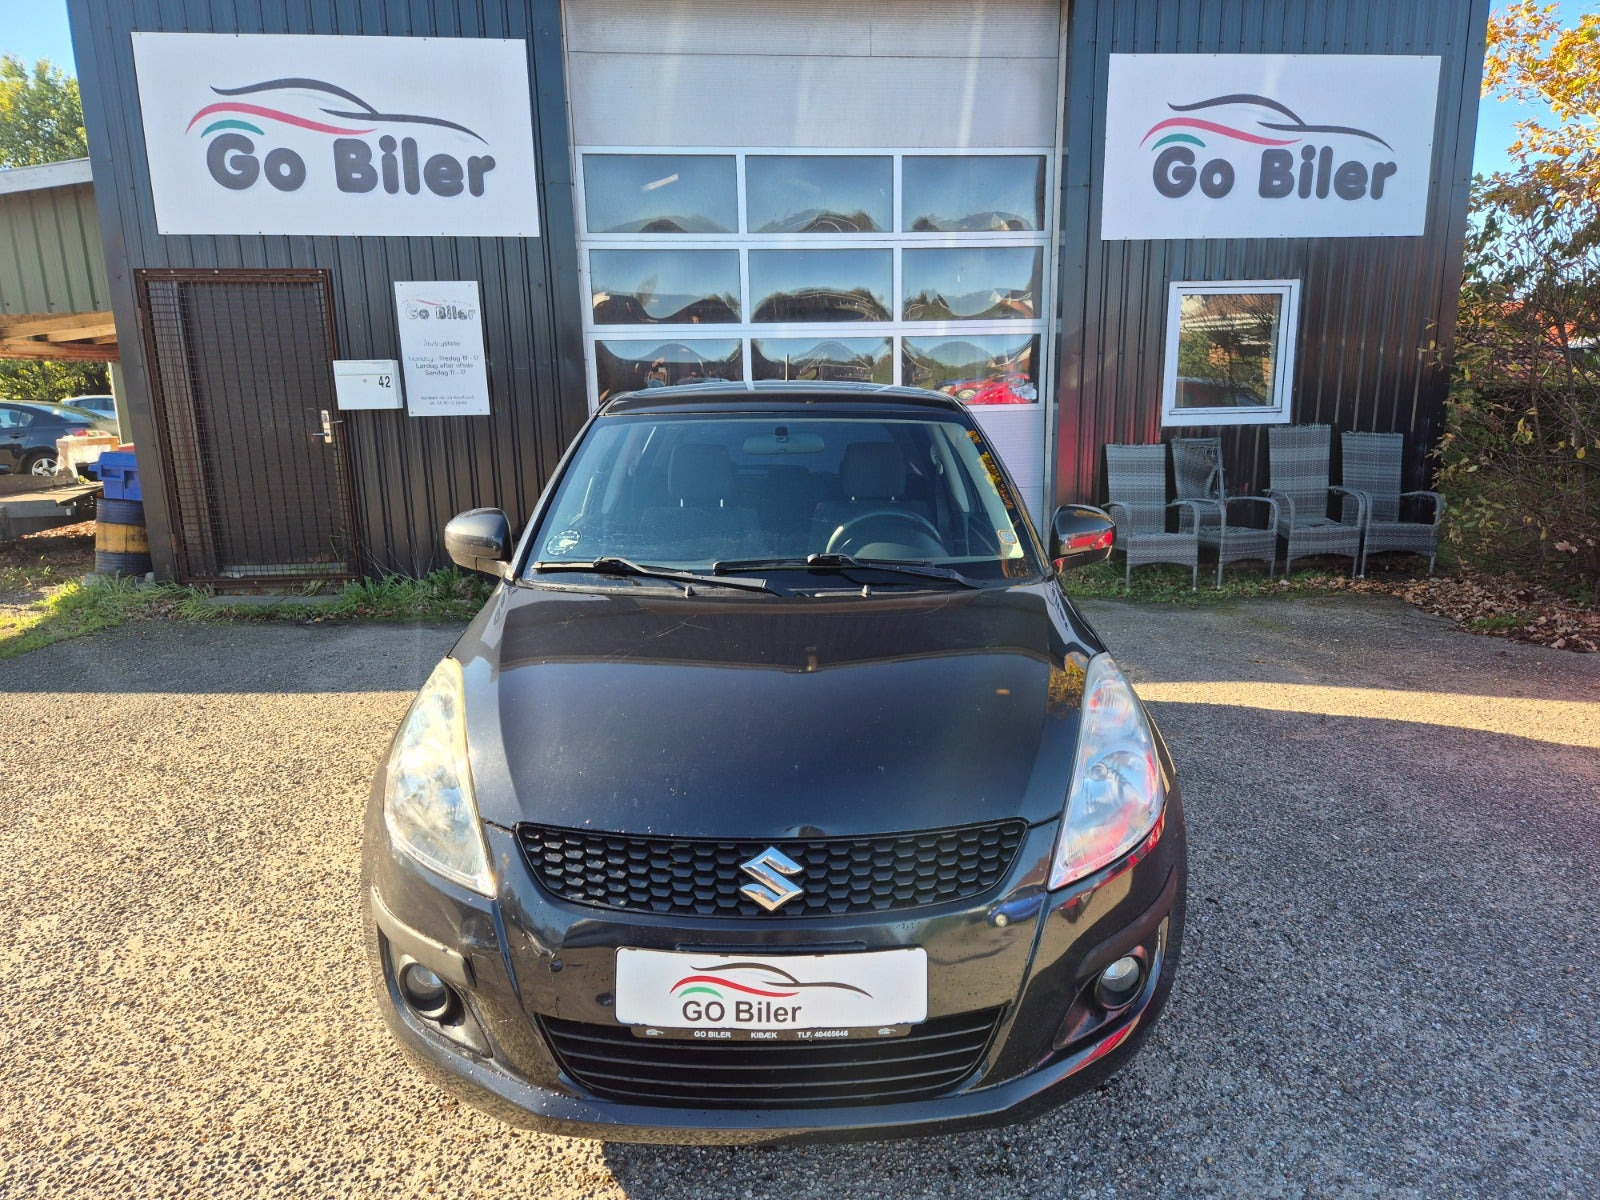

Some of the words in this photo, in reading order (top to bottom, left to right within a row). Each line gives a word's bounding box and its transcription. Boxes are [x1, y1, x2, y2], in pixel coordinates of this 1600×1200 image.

[206, 133, 307, 192] Go
[333, 134, 496, 197] Biler
[1152, 146, 1235, 199] Go
[1258, 144, 1397, 201] Biler
[406, 305, 430, 320] Go
[436, 305, 476, 320] Biler
[439, 355, 461, 363] Fredag
[378, 375, 391, 388] 42
[682, 1000, 726, 1022] GO
[735, 1001, 802, 1023] Biler
[693, 1030, 707, 1038] GO
[750, 1031, 778, 1039] KIBÆK
